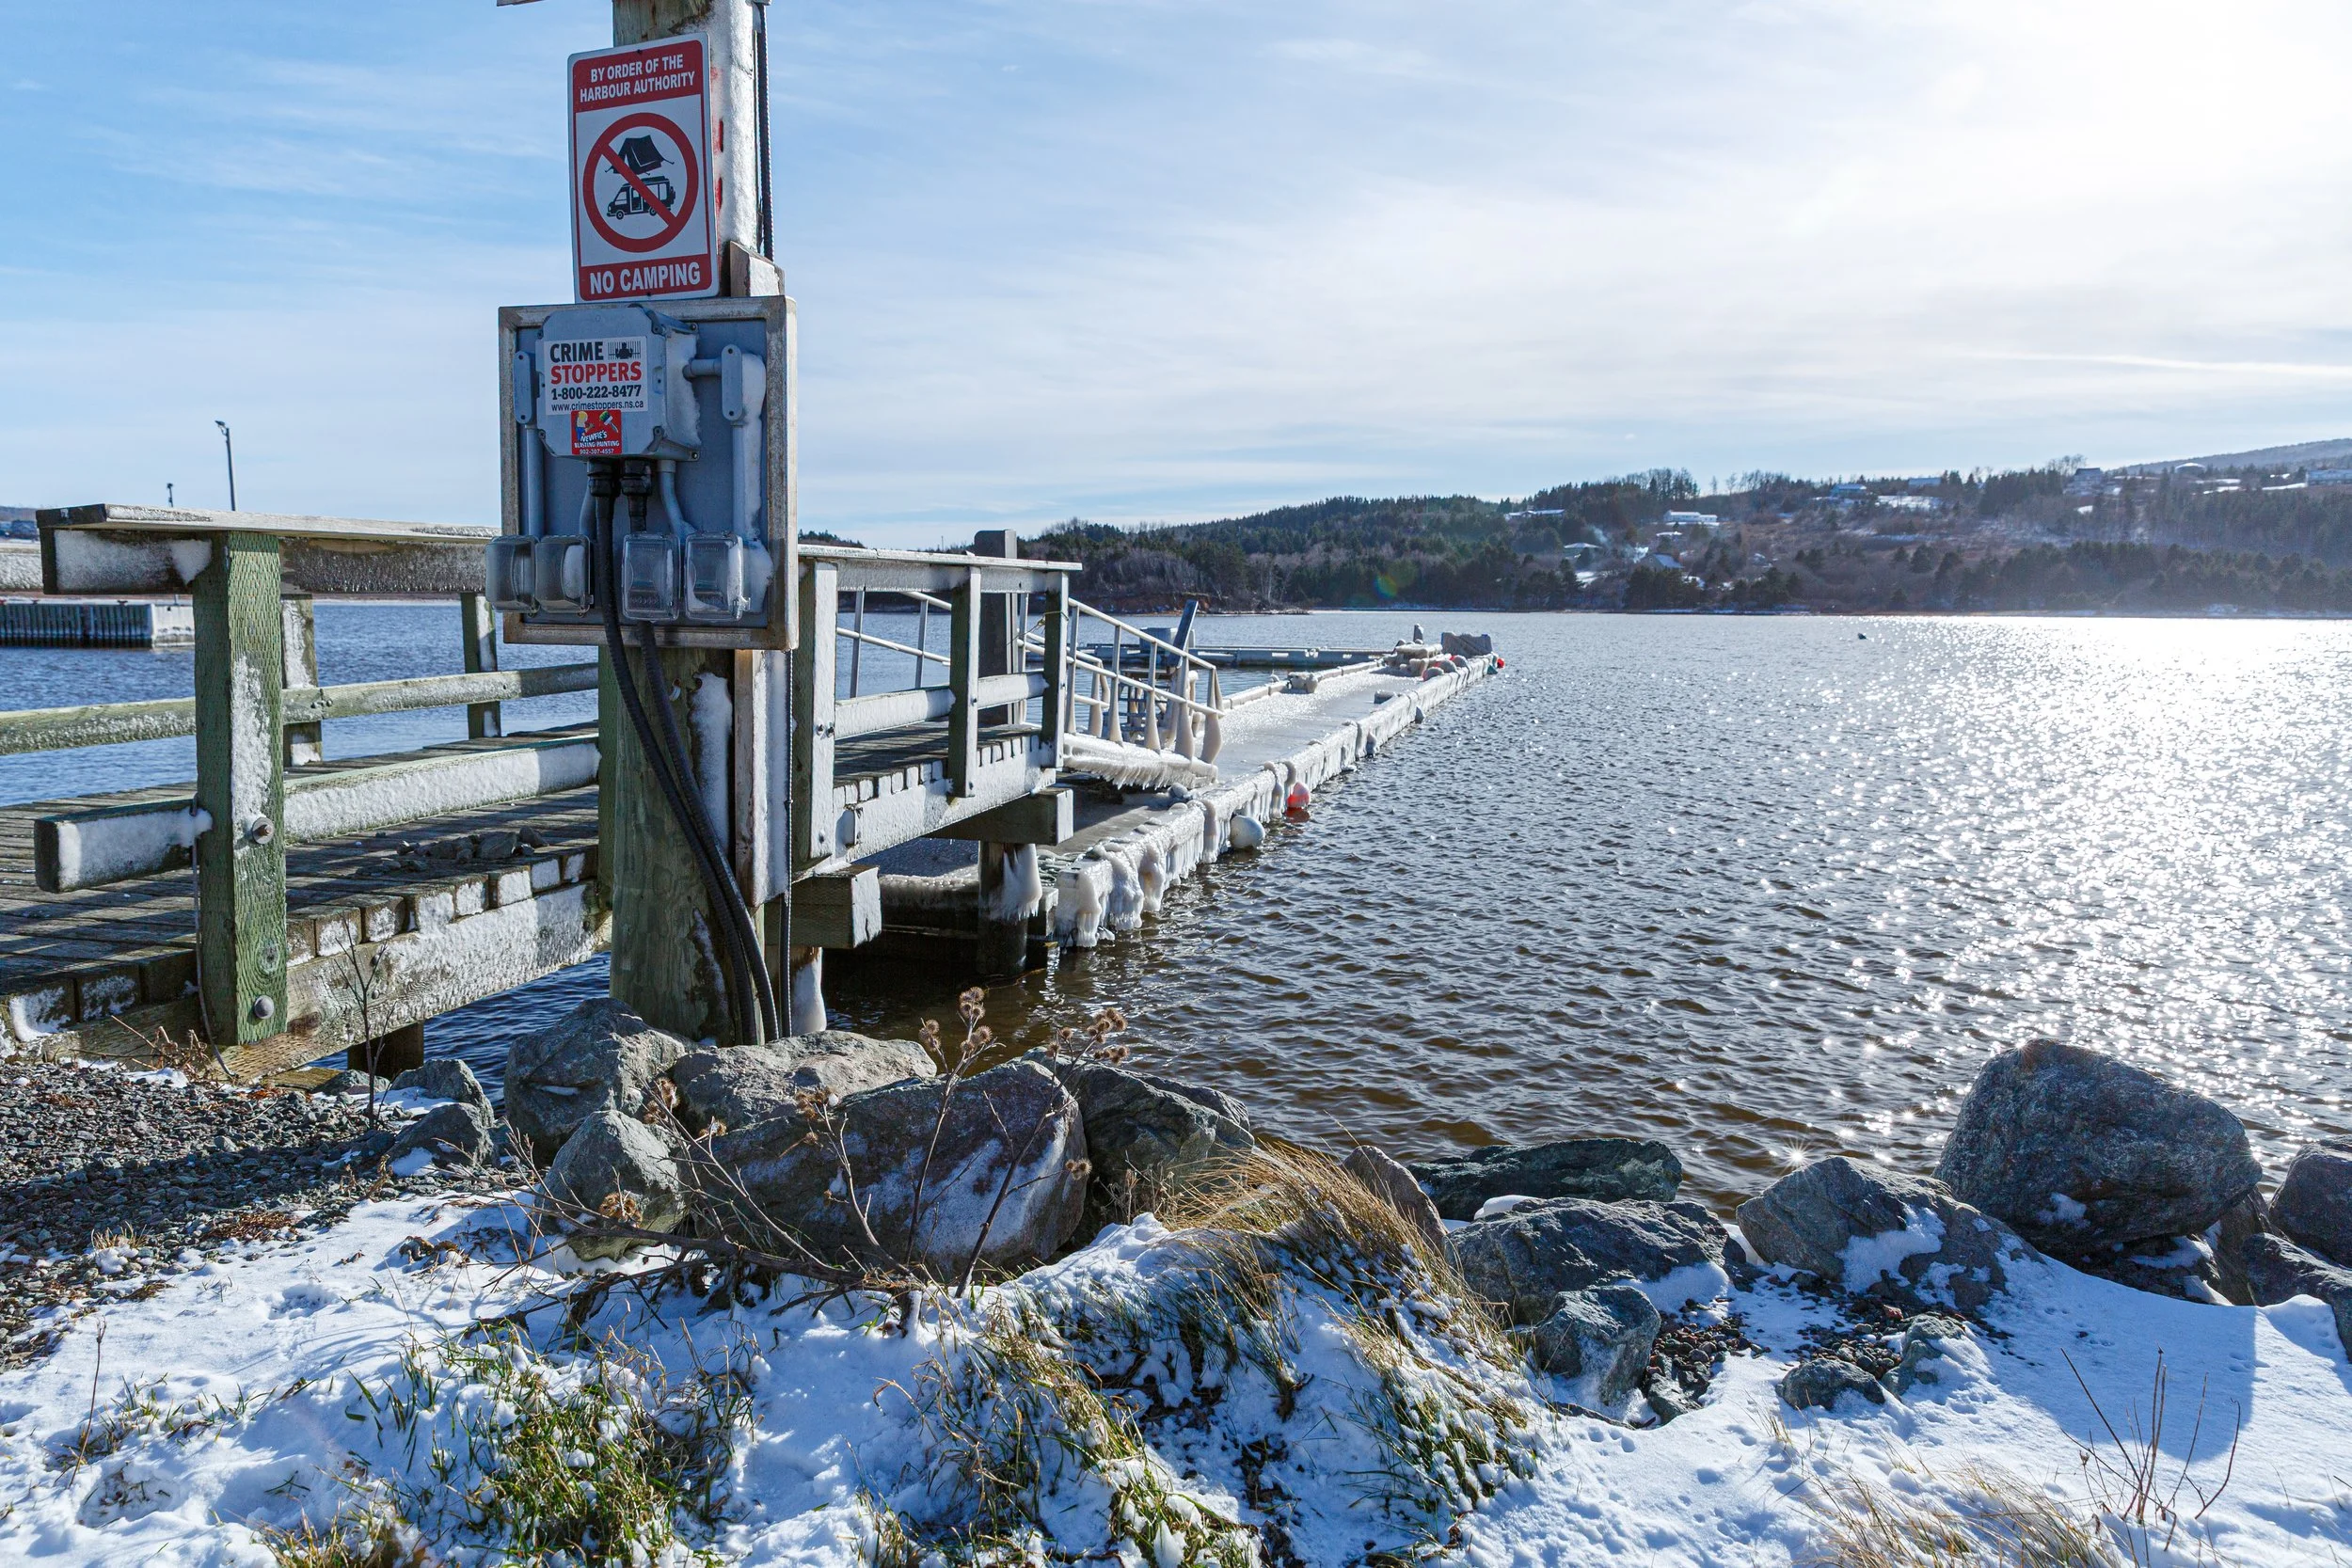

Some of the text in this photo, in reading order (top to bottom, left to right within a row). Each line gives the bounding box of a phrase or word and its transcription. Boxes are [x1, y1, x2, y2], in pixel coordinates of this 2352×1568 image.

[591, 54, 684, 83] BY ORDER OF THE
[580, 71, 695, 103] HARBOUR AUTHORITY
[590, 261, 701, 294] NO CAMPING
[549, 341, 604, 363] CRIME
[550, 361, 642, 385] STOPPERS
[551, 385, 642, 400] 1-800-222-8477
[551, 400, 644, 411] www.crimestoppers.ns.ca
